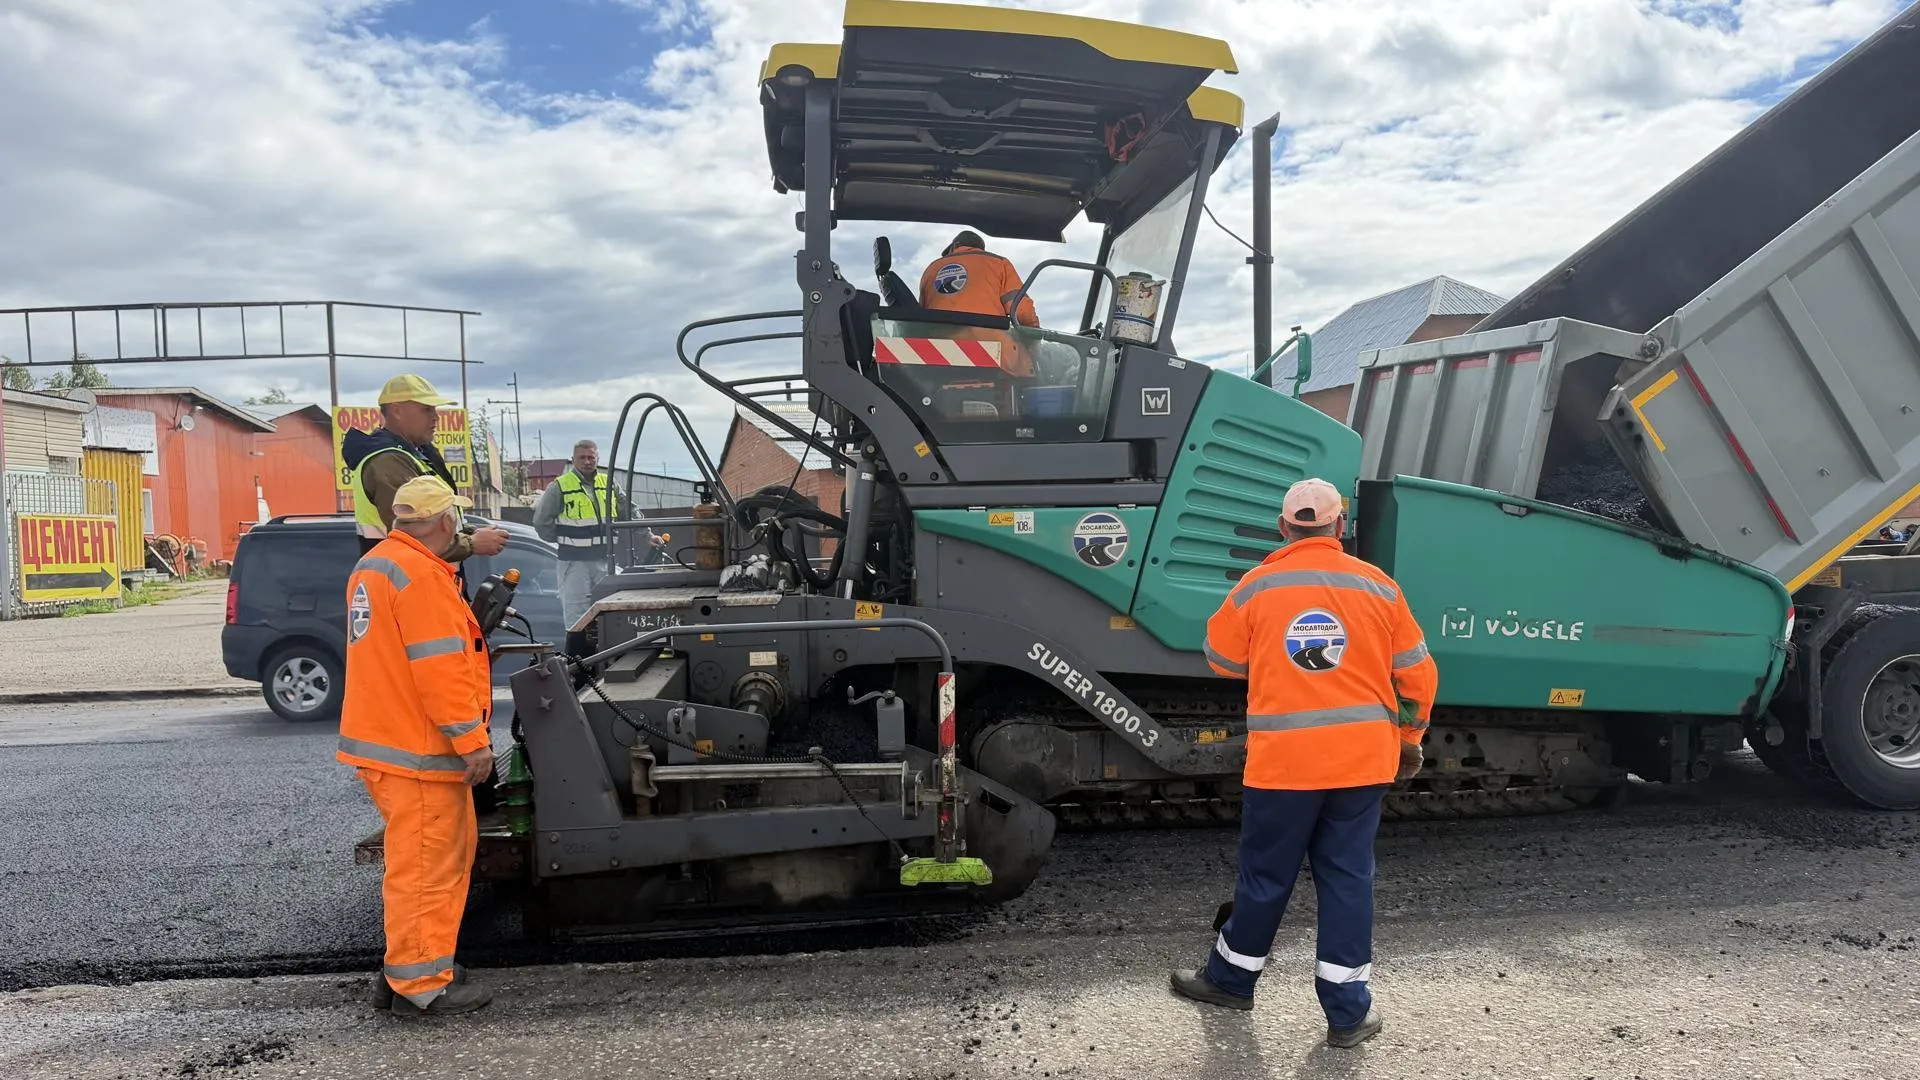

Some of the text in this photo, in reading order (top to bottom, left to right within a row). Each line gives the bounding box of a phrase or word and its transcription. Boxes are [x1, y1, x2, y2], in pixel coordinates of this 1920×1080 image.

[337, 408, 381, 432] ФАБР
[434, 433, 466, 445] СТОКИ
[1016, 520, 1029, 532] 108
[21, 518, 116, 572] ЦЕМЕНТ
[1293, 624, 1338, 632] МОСАВТОДОР
[1485, 610, 1584, 641] VÖGELE
[1027, 642, 1159, 747] SUPER 1800-3
